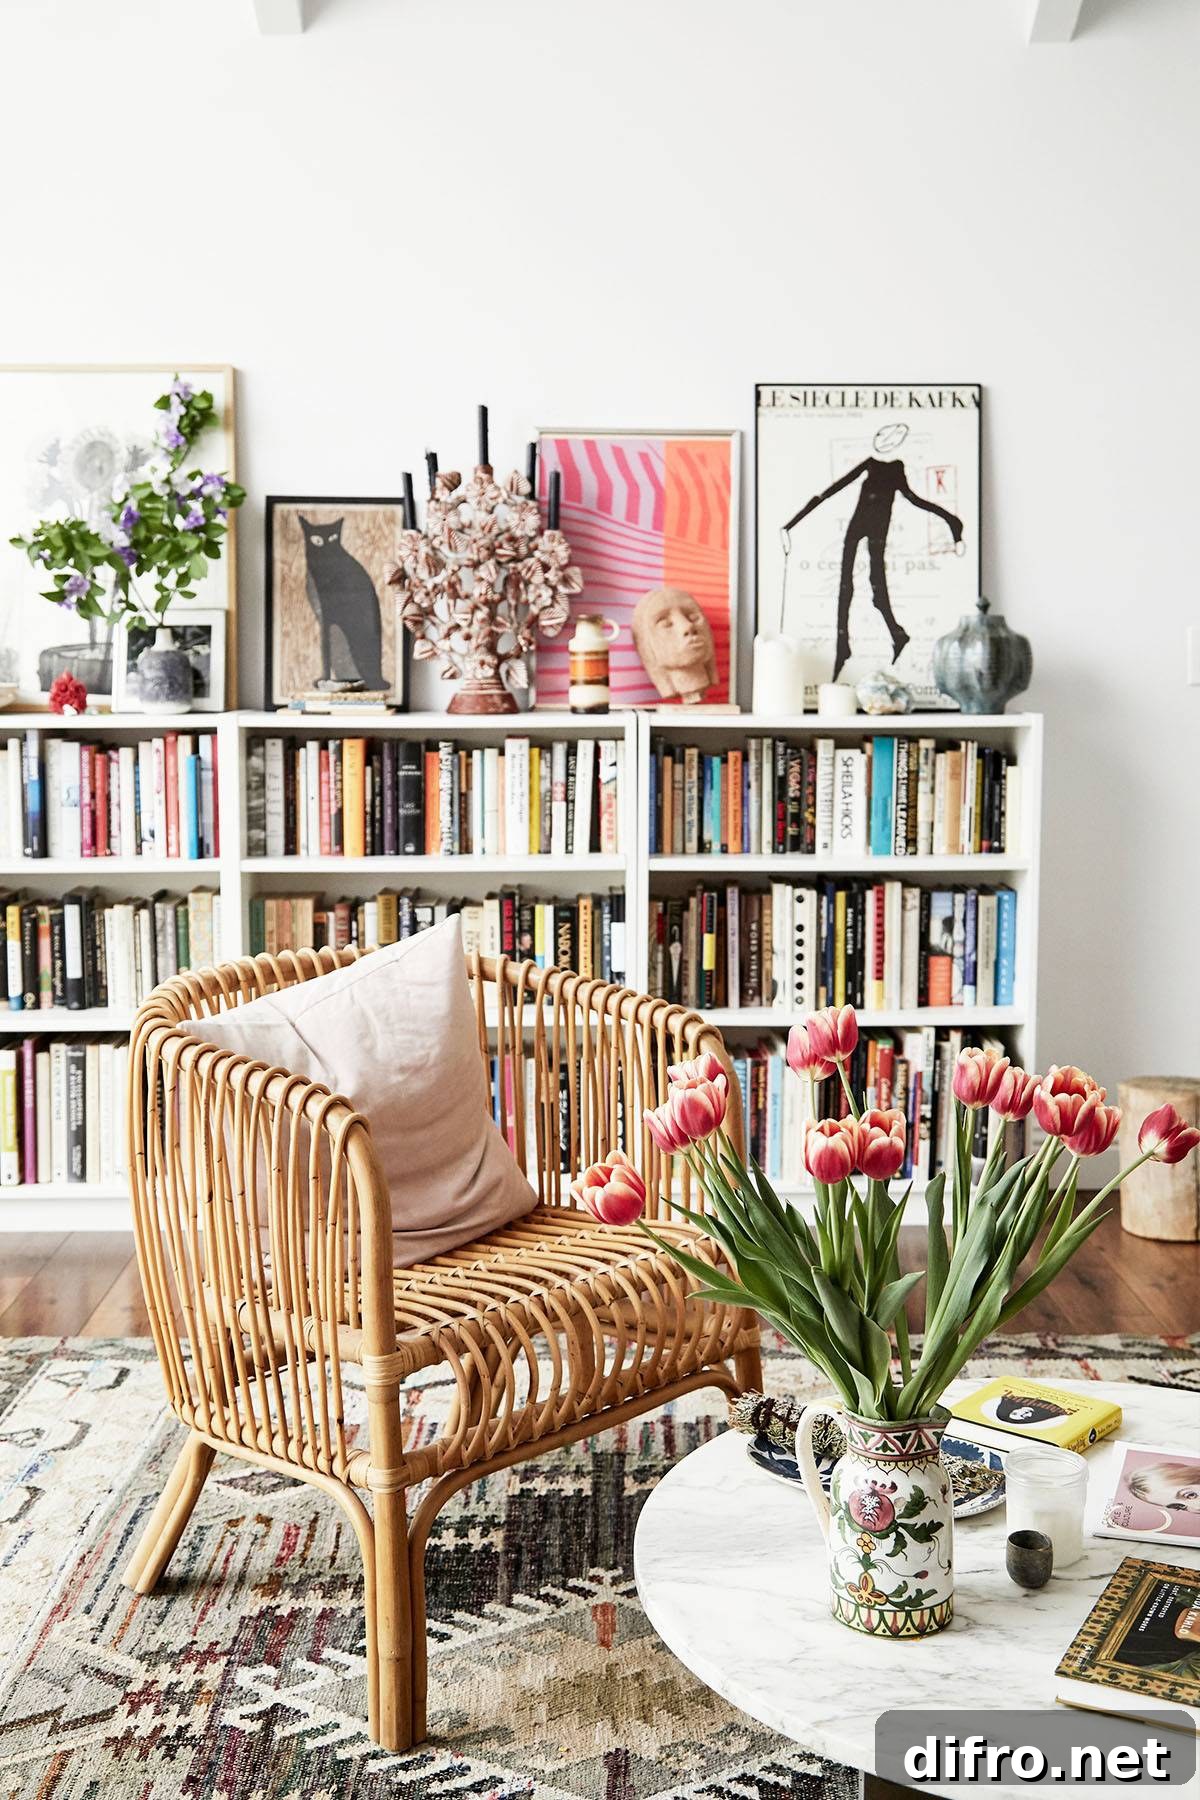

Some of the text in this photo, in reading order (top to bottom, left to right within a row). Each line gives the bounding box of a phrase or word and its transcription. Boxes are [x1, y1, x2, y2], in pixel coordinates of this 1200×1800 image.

[757, 390, 979, 409] LE SIECLE DE KAFKA
[897, 743, 908, 778] THINGS
[789, 760, 801, 798] VEGAS
[687, 795, 695, 817] White
[841, 756, 854, 839] SHEILA HICKS
[687, 819, 695, 843] Album
[895, 805, 906, 856] LEARNED
[750, 922, 758, 982] WORD VIRUS
[1158, 1585, 1180, 1618] LOST, DESTROYED
[1138, 1617, 1151, 1632] WORKS
[1179, 1610, 1198, 1634] KAHLO
